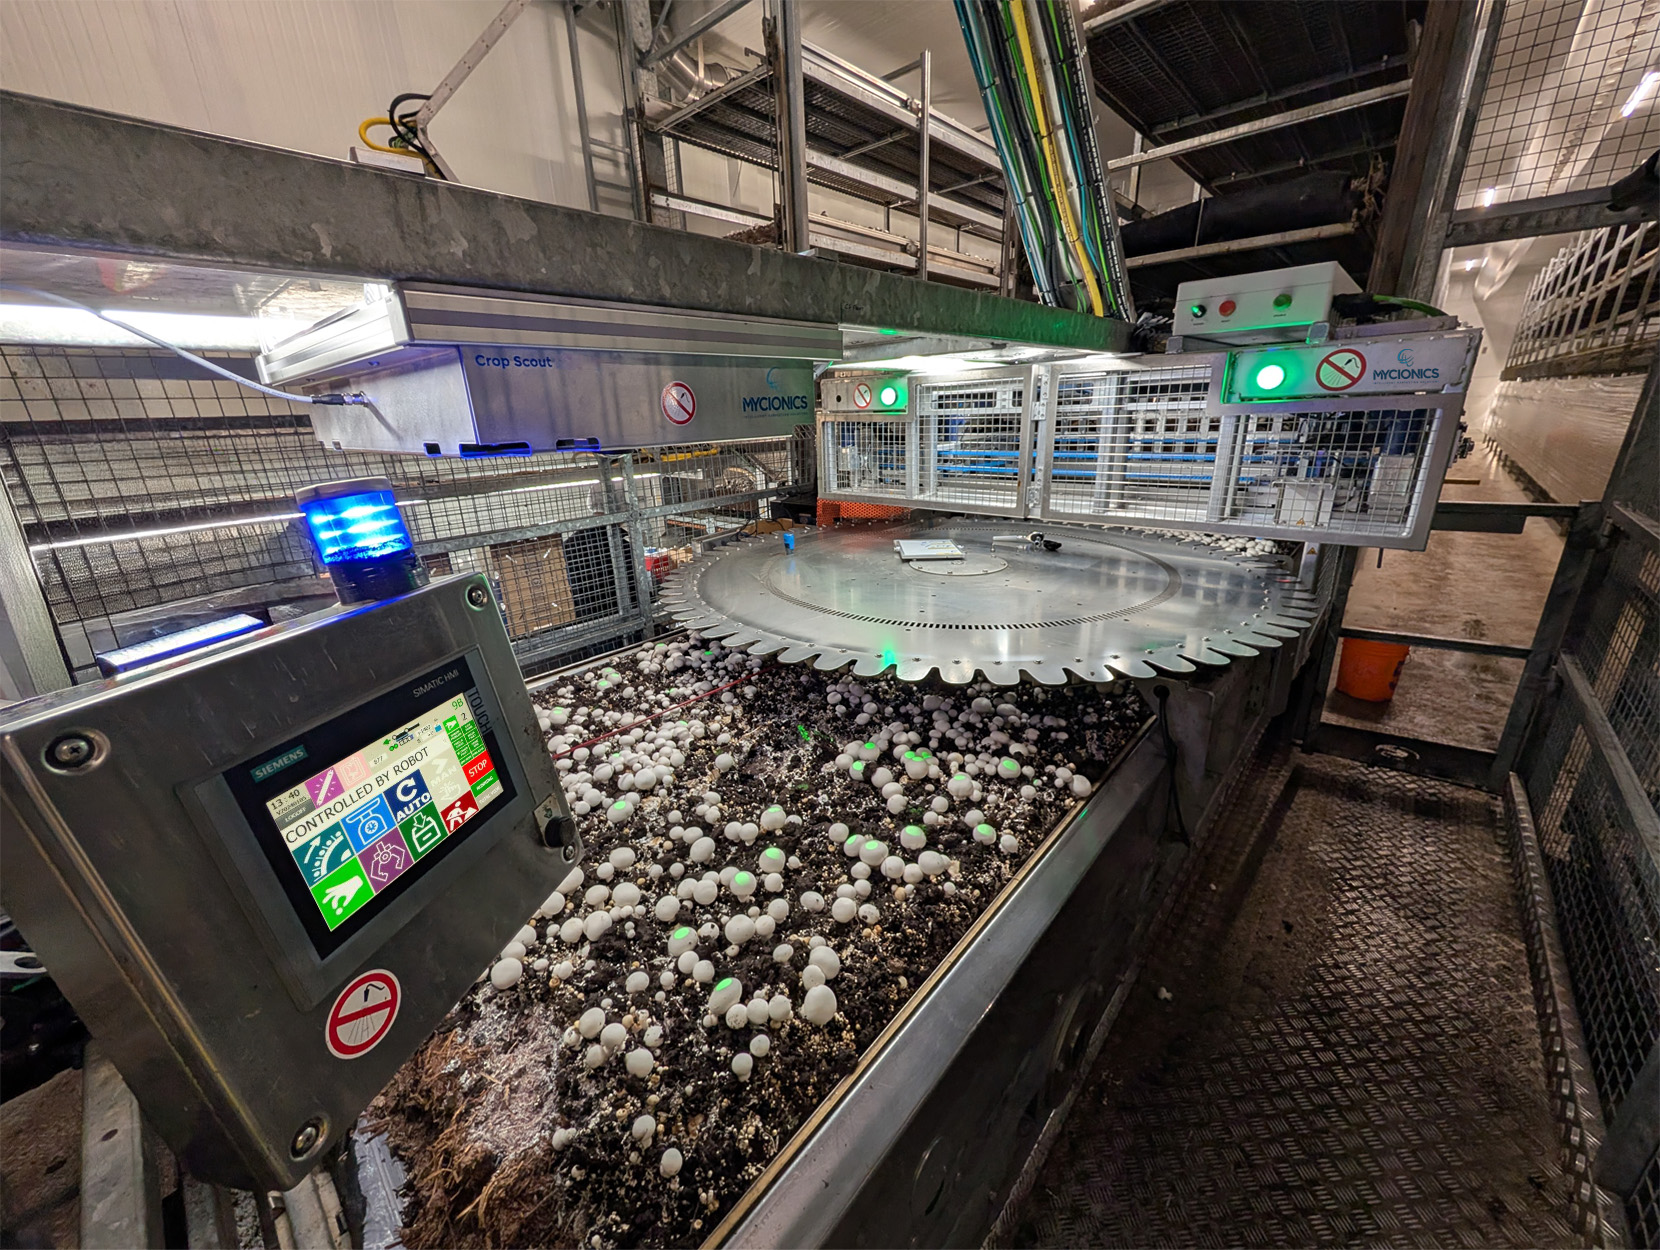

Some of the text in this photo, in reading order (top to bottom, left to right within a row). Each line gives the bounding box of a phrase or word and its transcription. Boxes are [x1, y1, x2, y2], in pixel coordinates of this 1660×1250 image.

[475, 354, 553, 369] Crop Scout
[1373, 368, 1440, 380] MYCIONICS
[742, 395, 808, 412] MYCIONICS
[412, 669, 459, 698] SIMATIC HMI
[467, 688, 492, 735] TOUCH
[255, 749, 304, 778] SIEMENS
[430, 765, 457, 787] MAN
[468, 758, 488, 777] STOP
[285, 746, 429, 844] CONTROLLED BY ROBOT
[396, 791, 431, 822] AUTO
